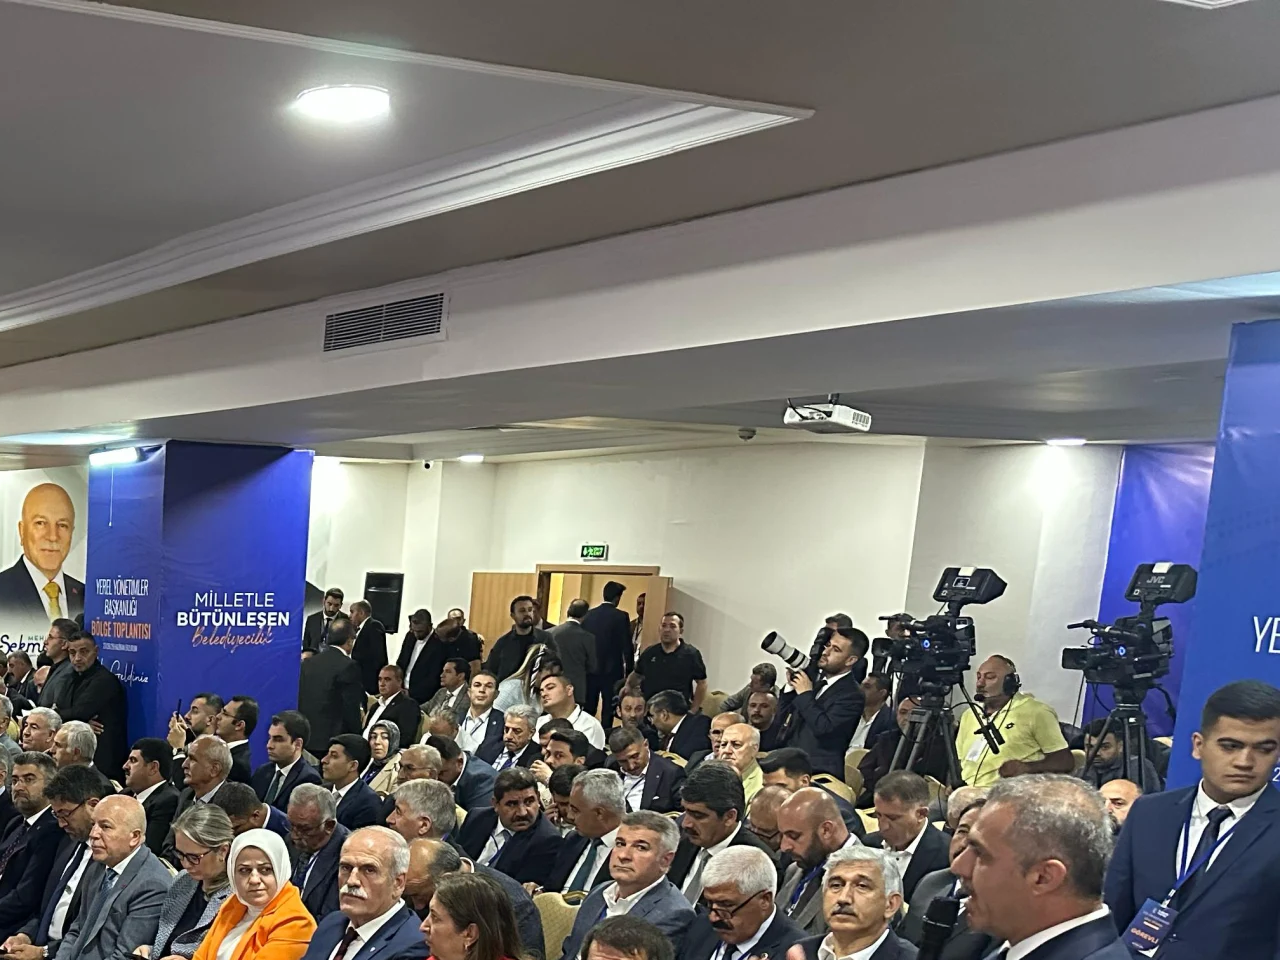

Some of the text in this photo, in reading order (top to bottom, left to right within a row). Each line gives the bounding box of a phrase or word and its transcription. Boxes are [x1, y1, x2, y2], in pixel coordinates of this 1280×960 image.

[1146, 576, 1165, 584] JVC
[195, 589, 275, 607] MİLLETLE
[91, 617, 151, 640] BÖLGE TOPLANTISI
[177, 608, 290, 629] BÜTÜNLEŞEN
[192, 626, 274, 653] Belediyecilik
